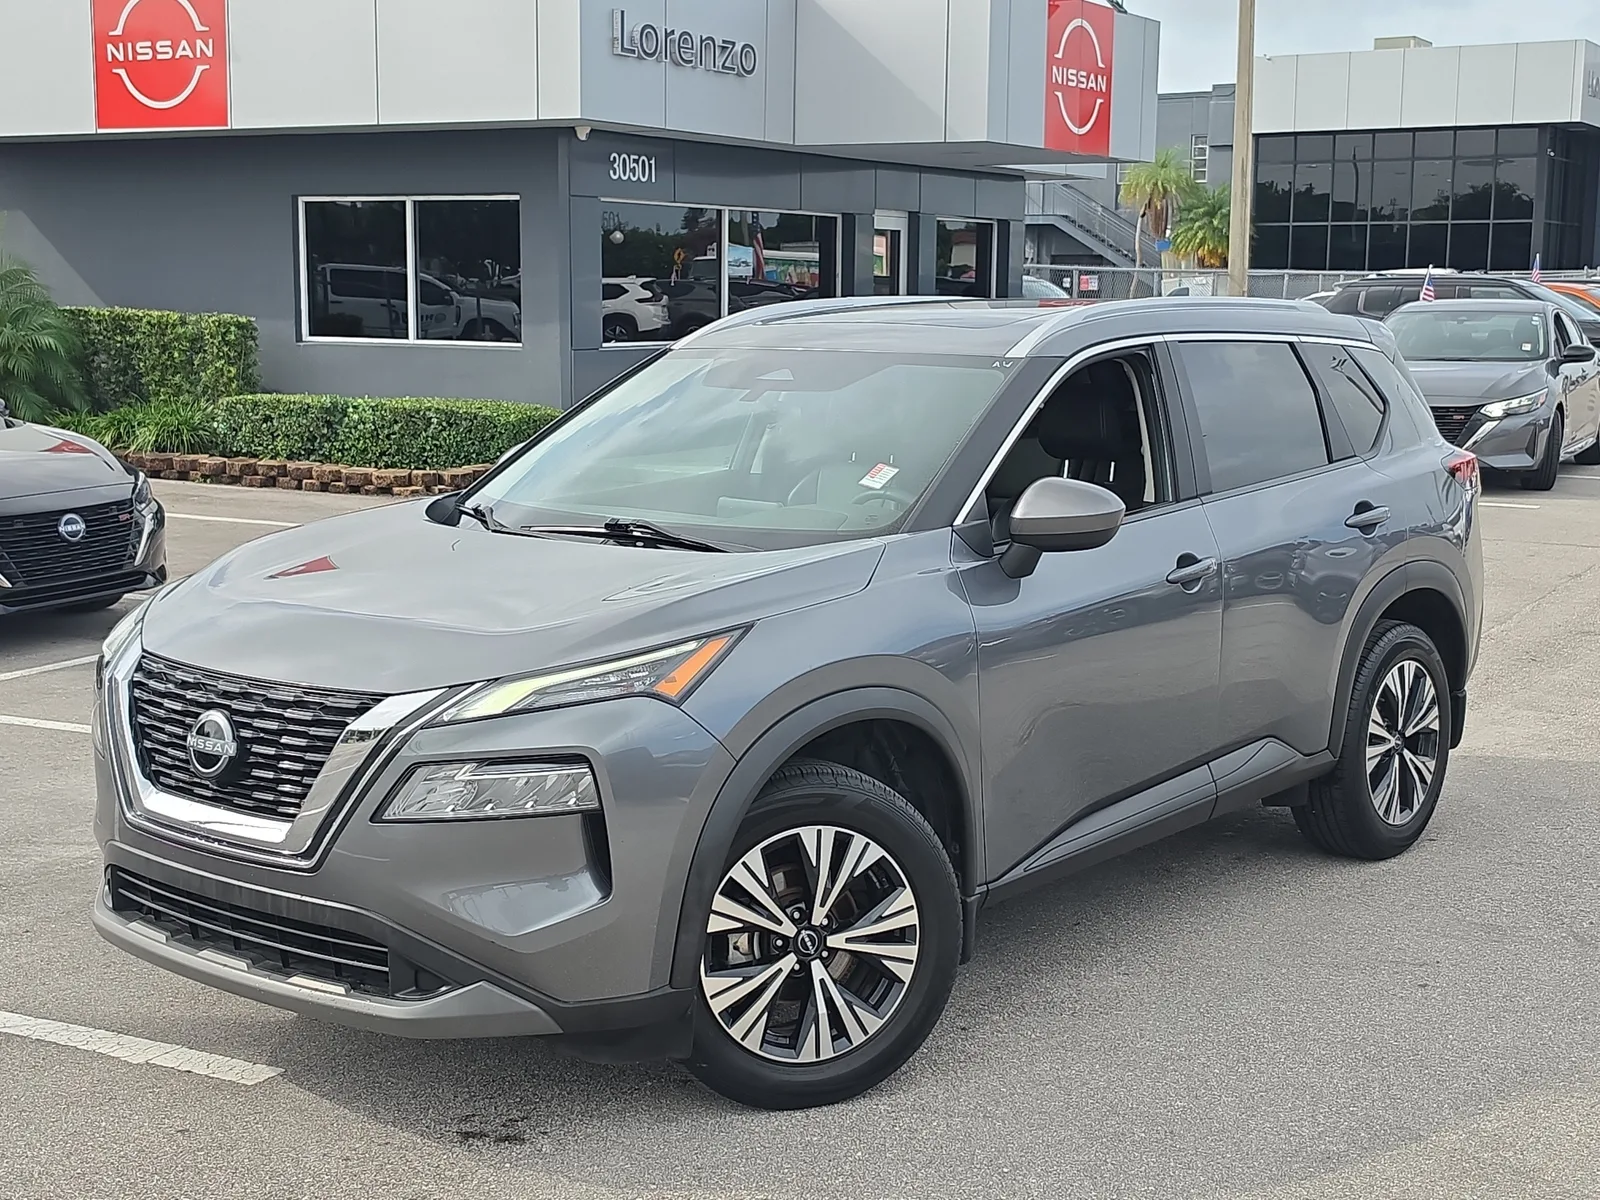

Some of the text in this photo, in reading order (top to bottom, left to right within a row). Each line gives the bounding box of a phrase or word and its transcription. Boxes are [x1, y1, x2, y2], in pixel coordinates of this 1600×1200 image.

[106, 38, 213, 62] NISSAN
[611, 8, 758, 77] Lorenzo
[1052, 65, 1107, 93] NISSAN
[609, 152, 656, 183] 30501
[187, 732, 236, 755] NISSAN
